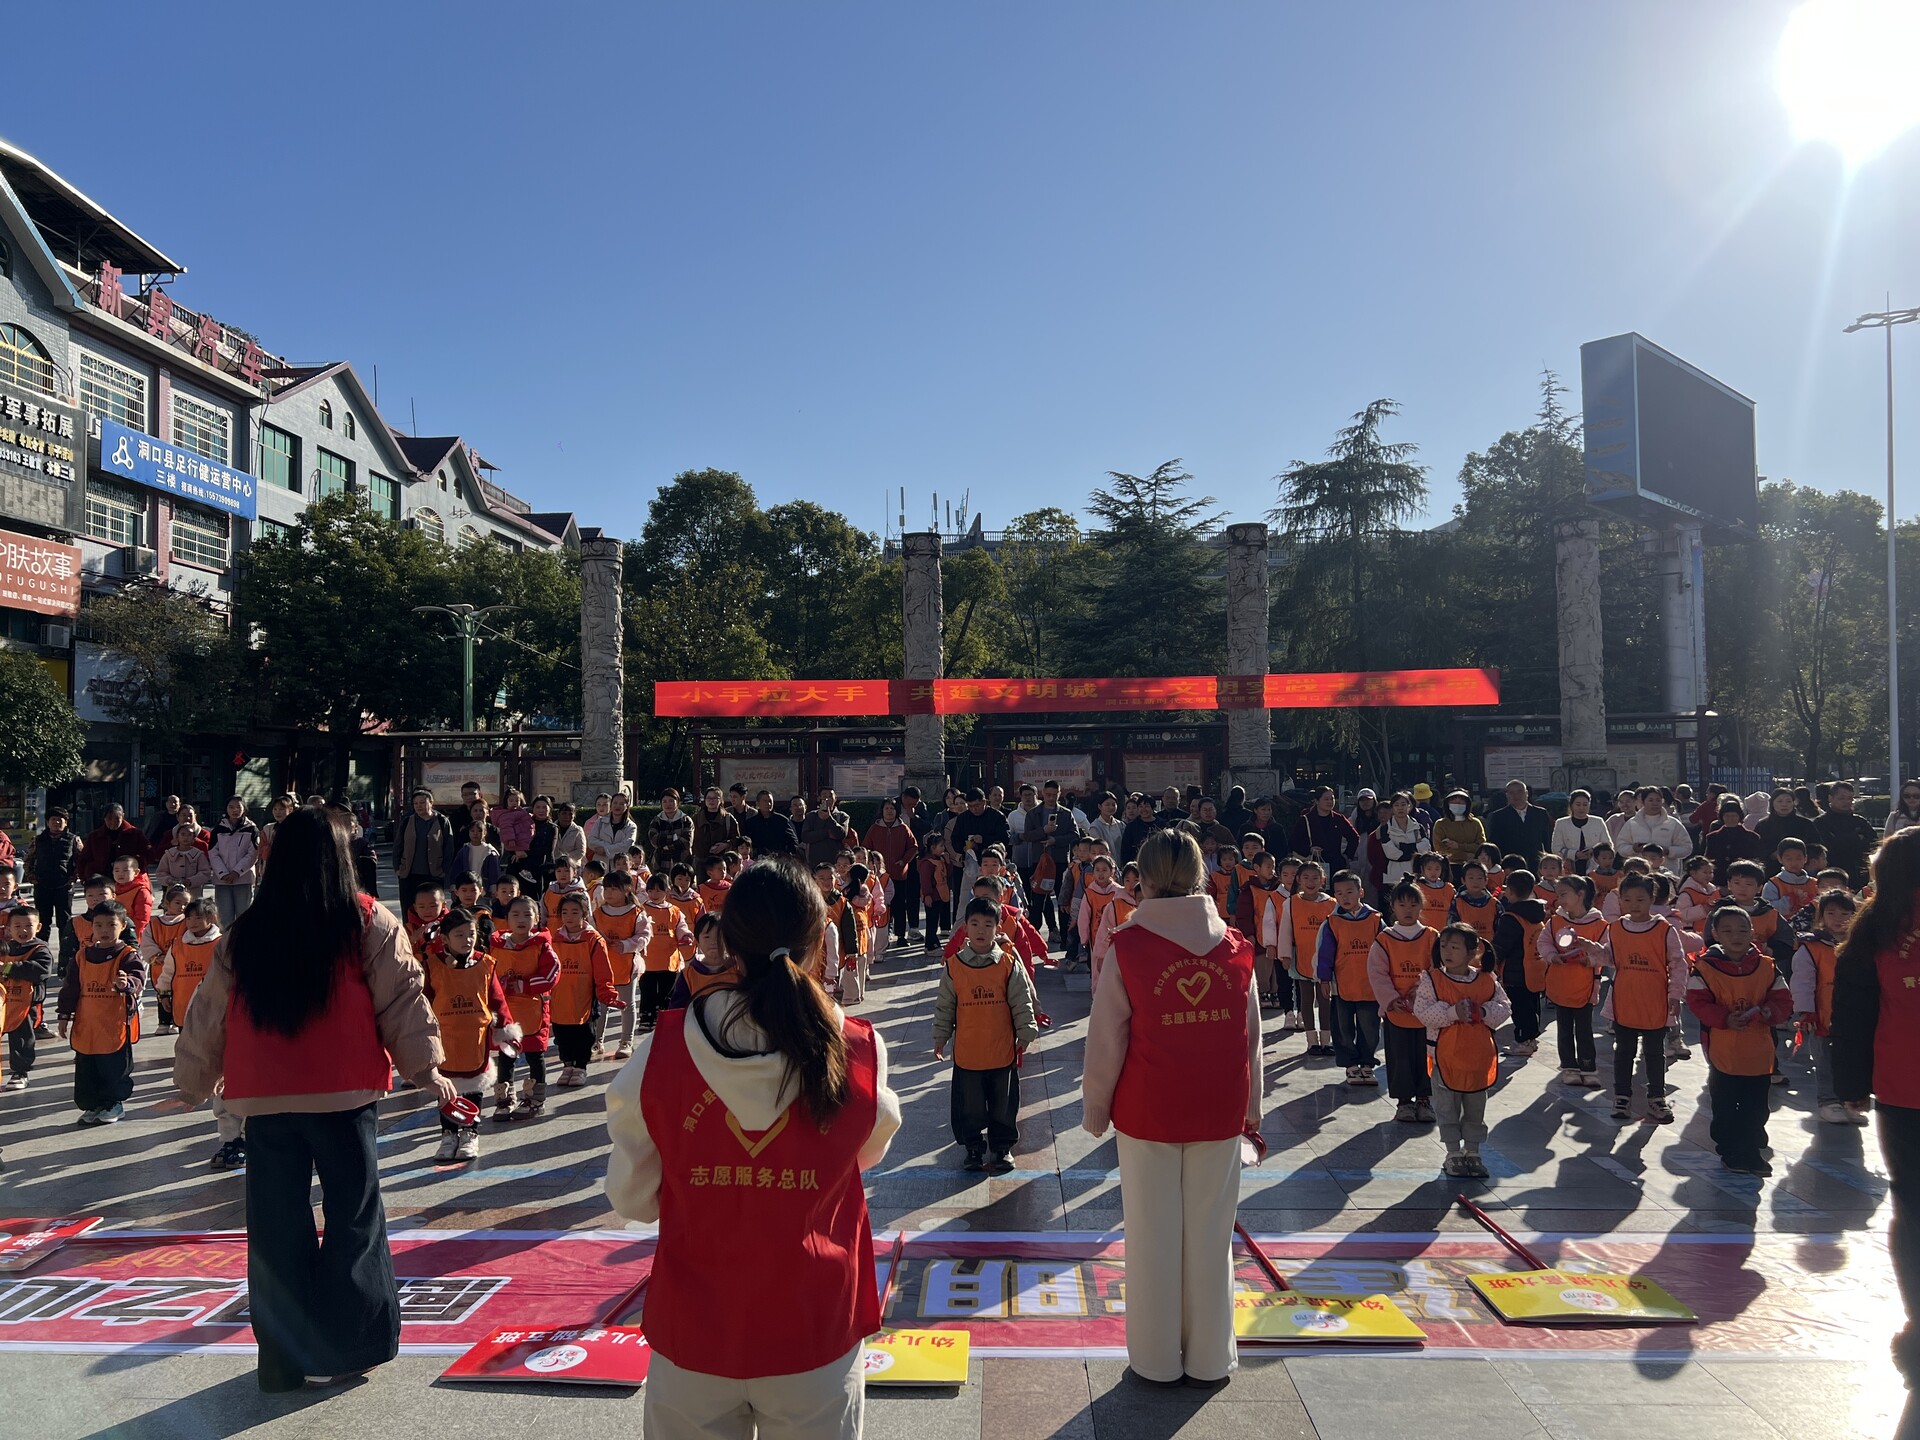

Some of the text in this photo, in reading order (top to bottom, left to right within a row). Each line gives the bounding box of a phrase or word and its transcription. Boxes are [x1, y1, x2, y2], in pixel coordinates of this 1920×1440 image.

[0, 393, 74, 440] 军事拓展
[138, 438, 252, 497] 洞口县足行健运营中心
[156, 469, 176, 489] 三楼
[0, 573, 74, 596] FUGUSHI
[1153, 958, 1232, 996] 洞口县新时代文明实践中心
[1161, 1008, 1232, 1026] 志愿服务总队
[690, 1165, 819, 1190] 志愿服务总队
